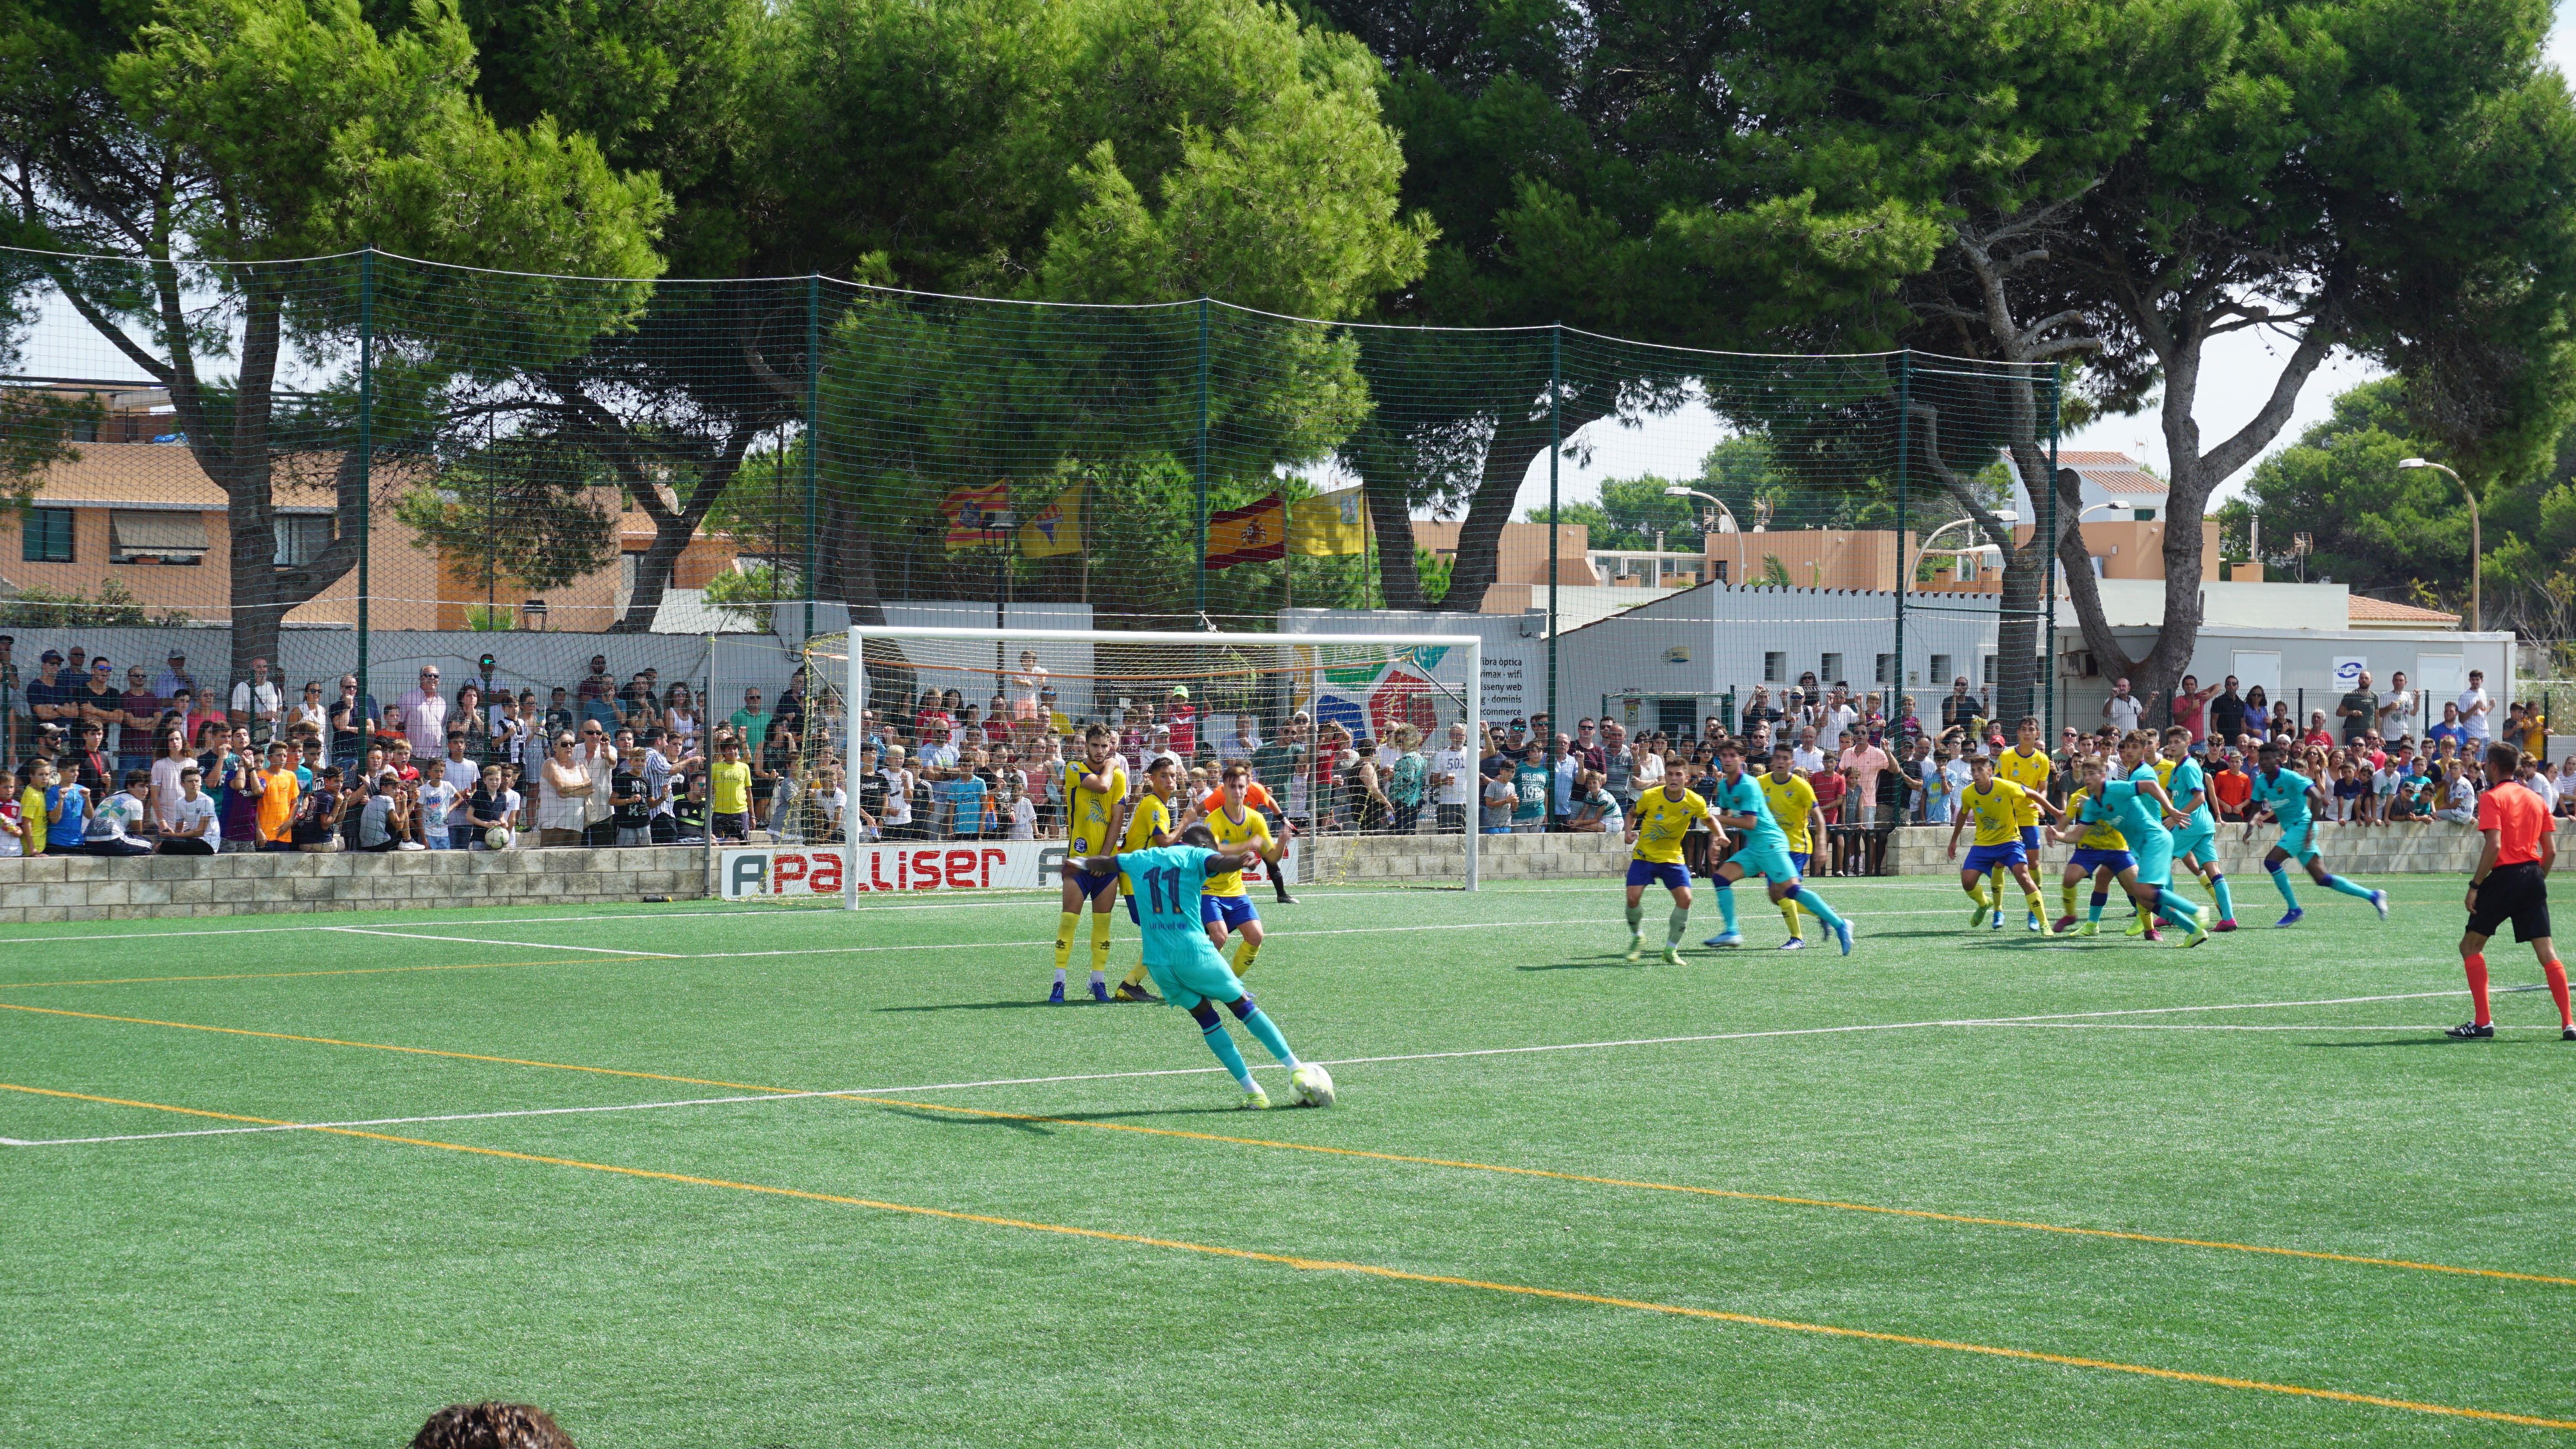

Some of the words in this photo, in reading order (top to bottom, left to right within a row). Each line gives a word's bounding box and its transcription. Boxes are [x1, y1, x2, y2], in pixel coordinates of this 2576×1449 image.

[1499, 658, 1522, 668] òptica
[1507, 670, 1522, 678] wifi
[1481, 682, 1504, 693] isseny
[1492, 695, 1522, 703] dominis
[1446, 756, 1465, 770] 501
[1142, 866, 1184, 914] 11
